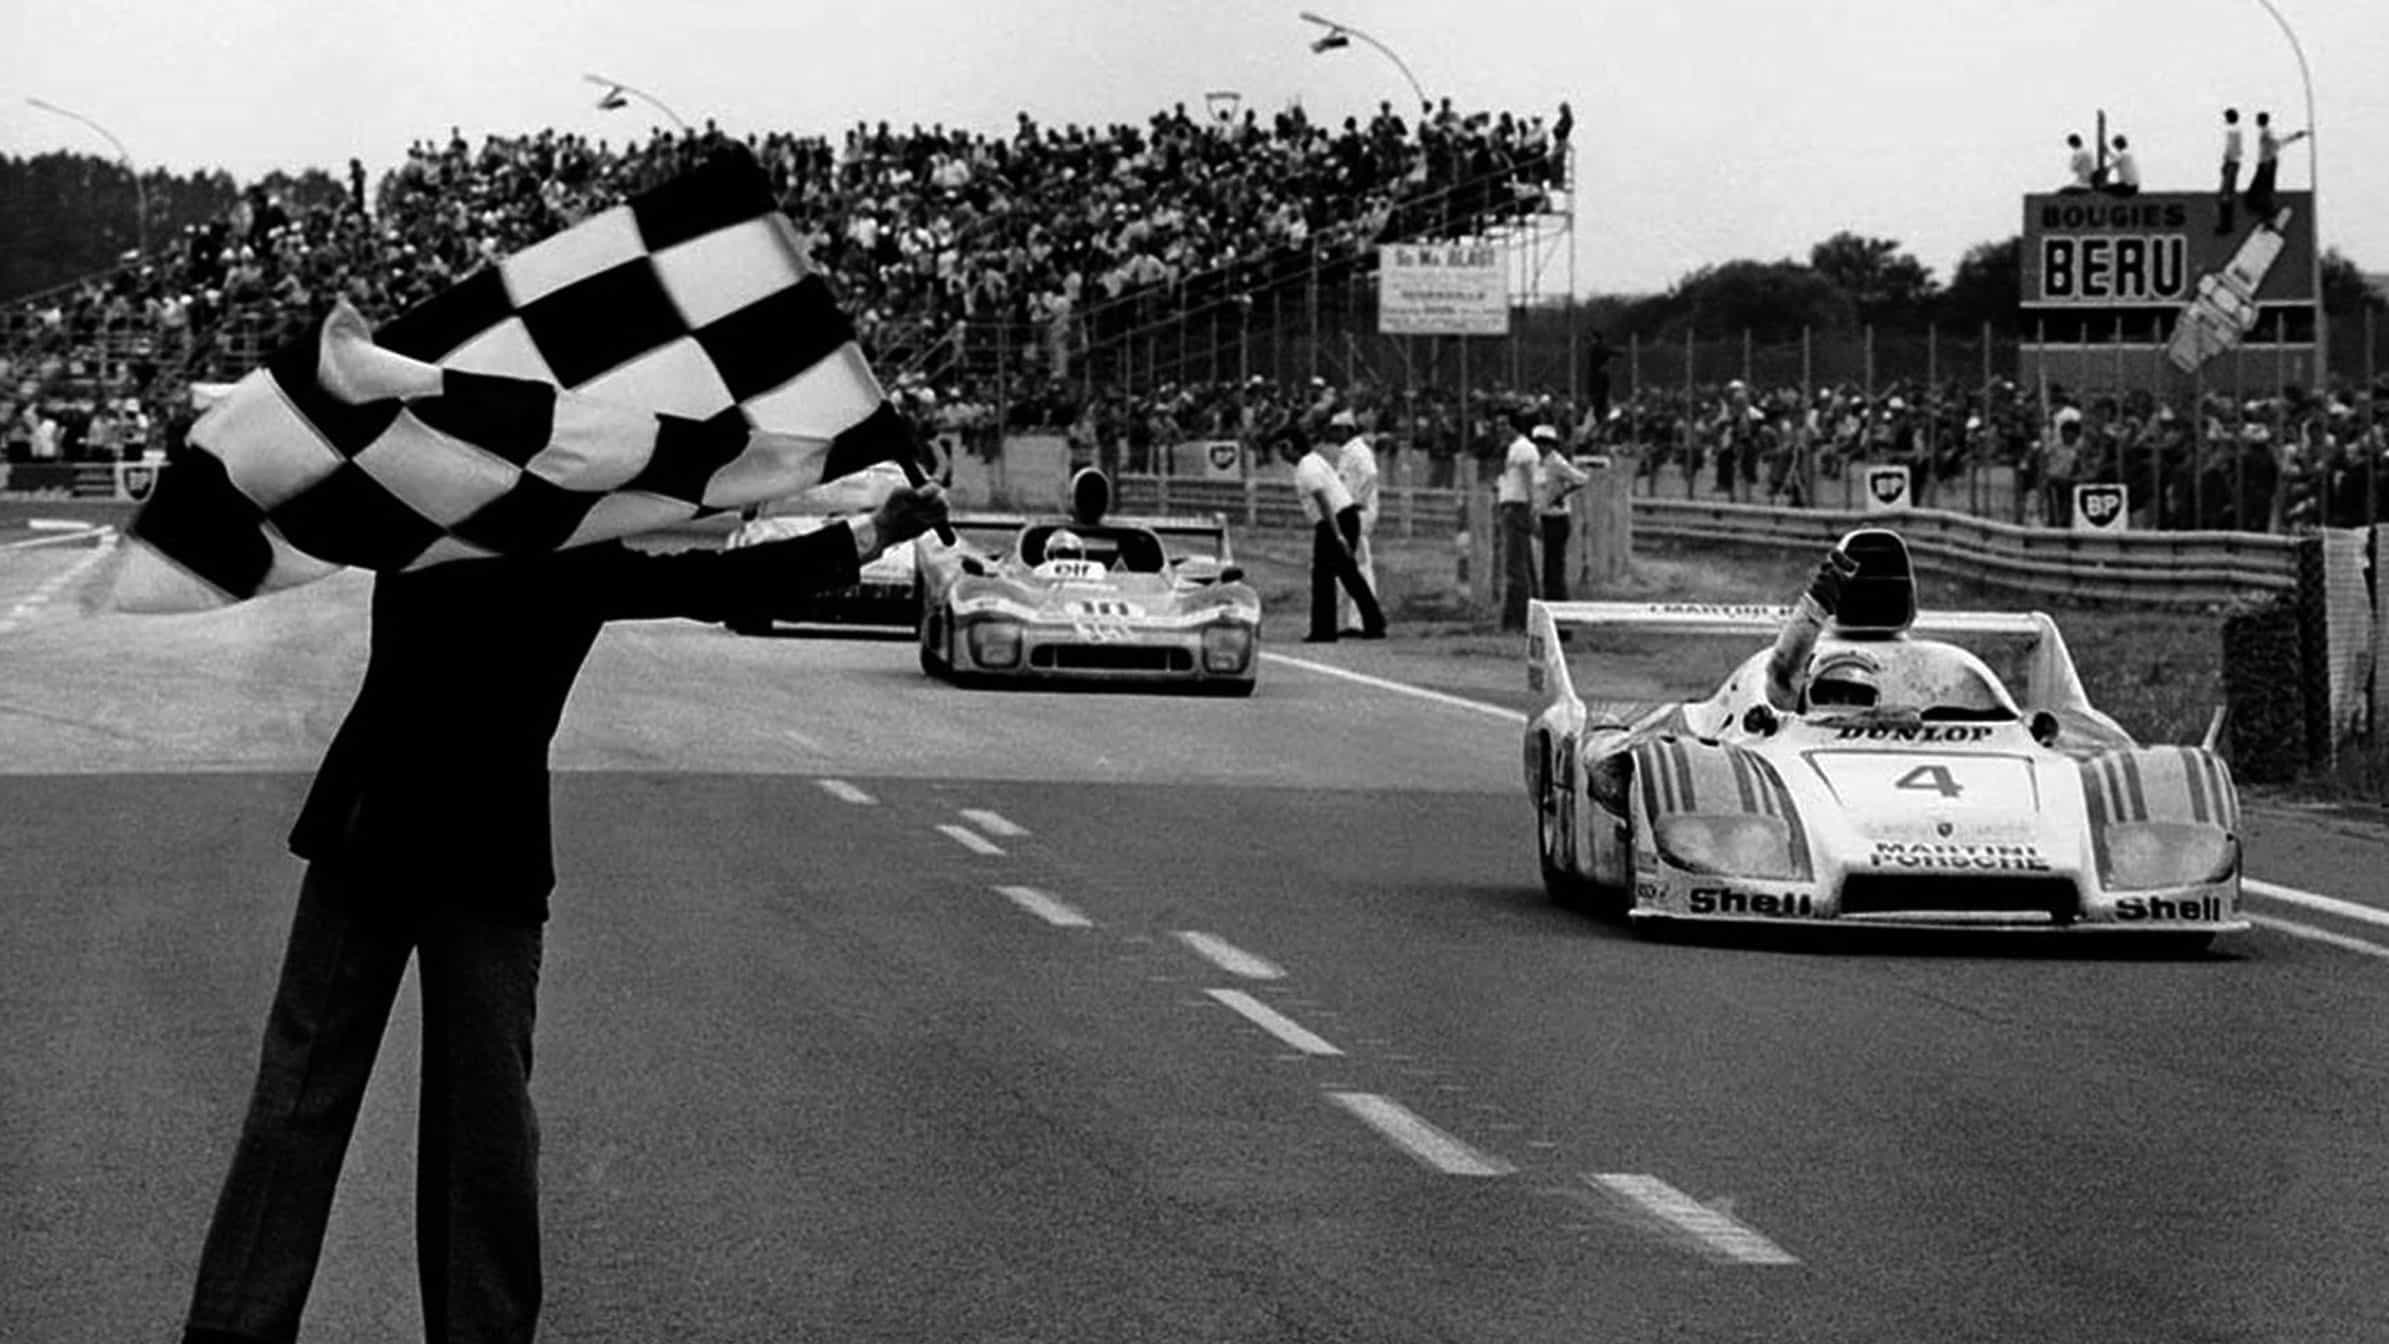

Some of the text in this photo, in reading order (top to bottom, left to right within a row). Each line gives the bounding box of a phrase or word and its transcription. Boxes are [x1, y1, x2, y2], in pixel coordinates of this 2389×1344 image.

[2042, 205, 2186, 228] BOUGIES
[2042, 235, 2187, 297] BERU
[2087, 494, 2119, 516] BP
[1835, 725, 1993, 742] DUNLOP
[1896, 764, 1964, 797] 4
[1877, 843, 2037, 857] MARTINI
[1871, 854, 2051, 871] PORSCHE
[1690, 887, 1812, 916] Shell
[2116, 896, 2220, 922] Shell
